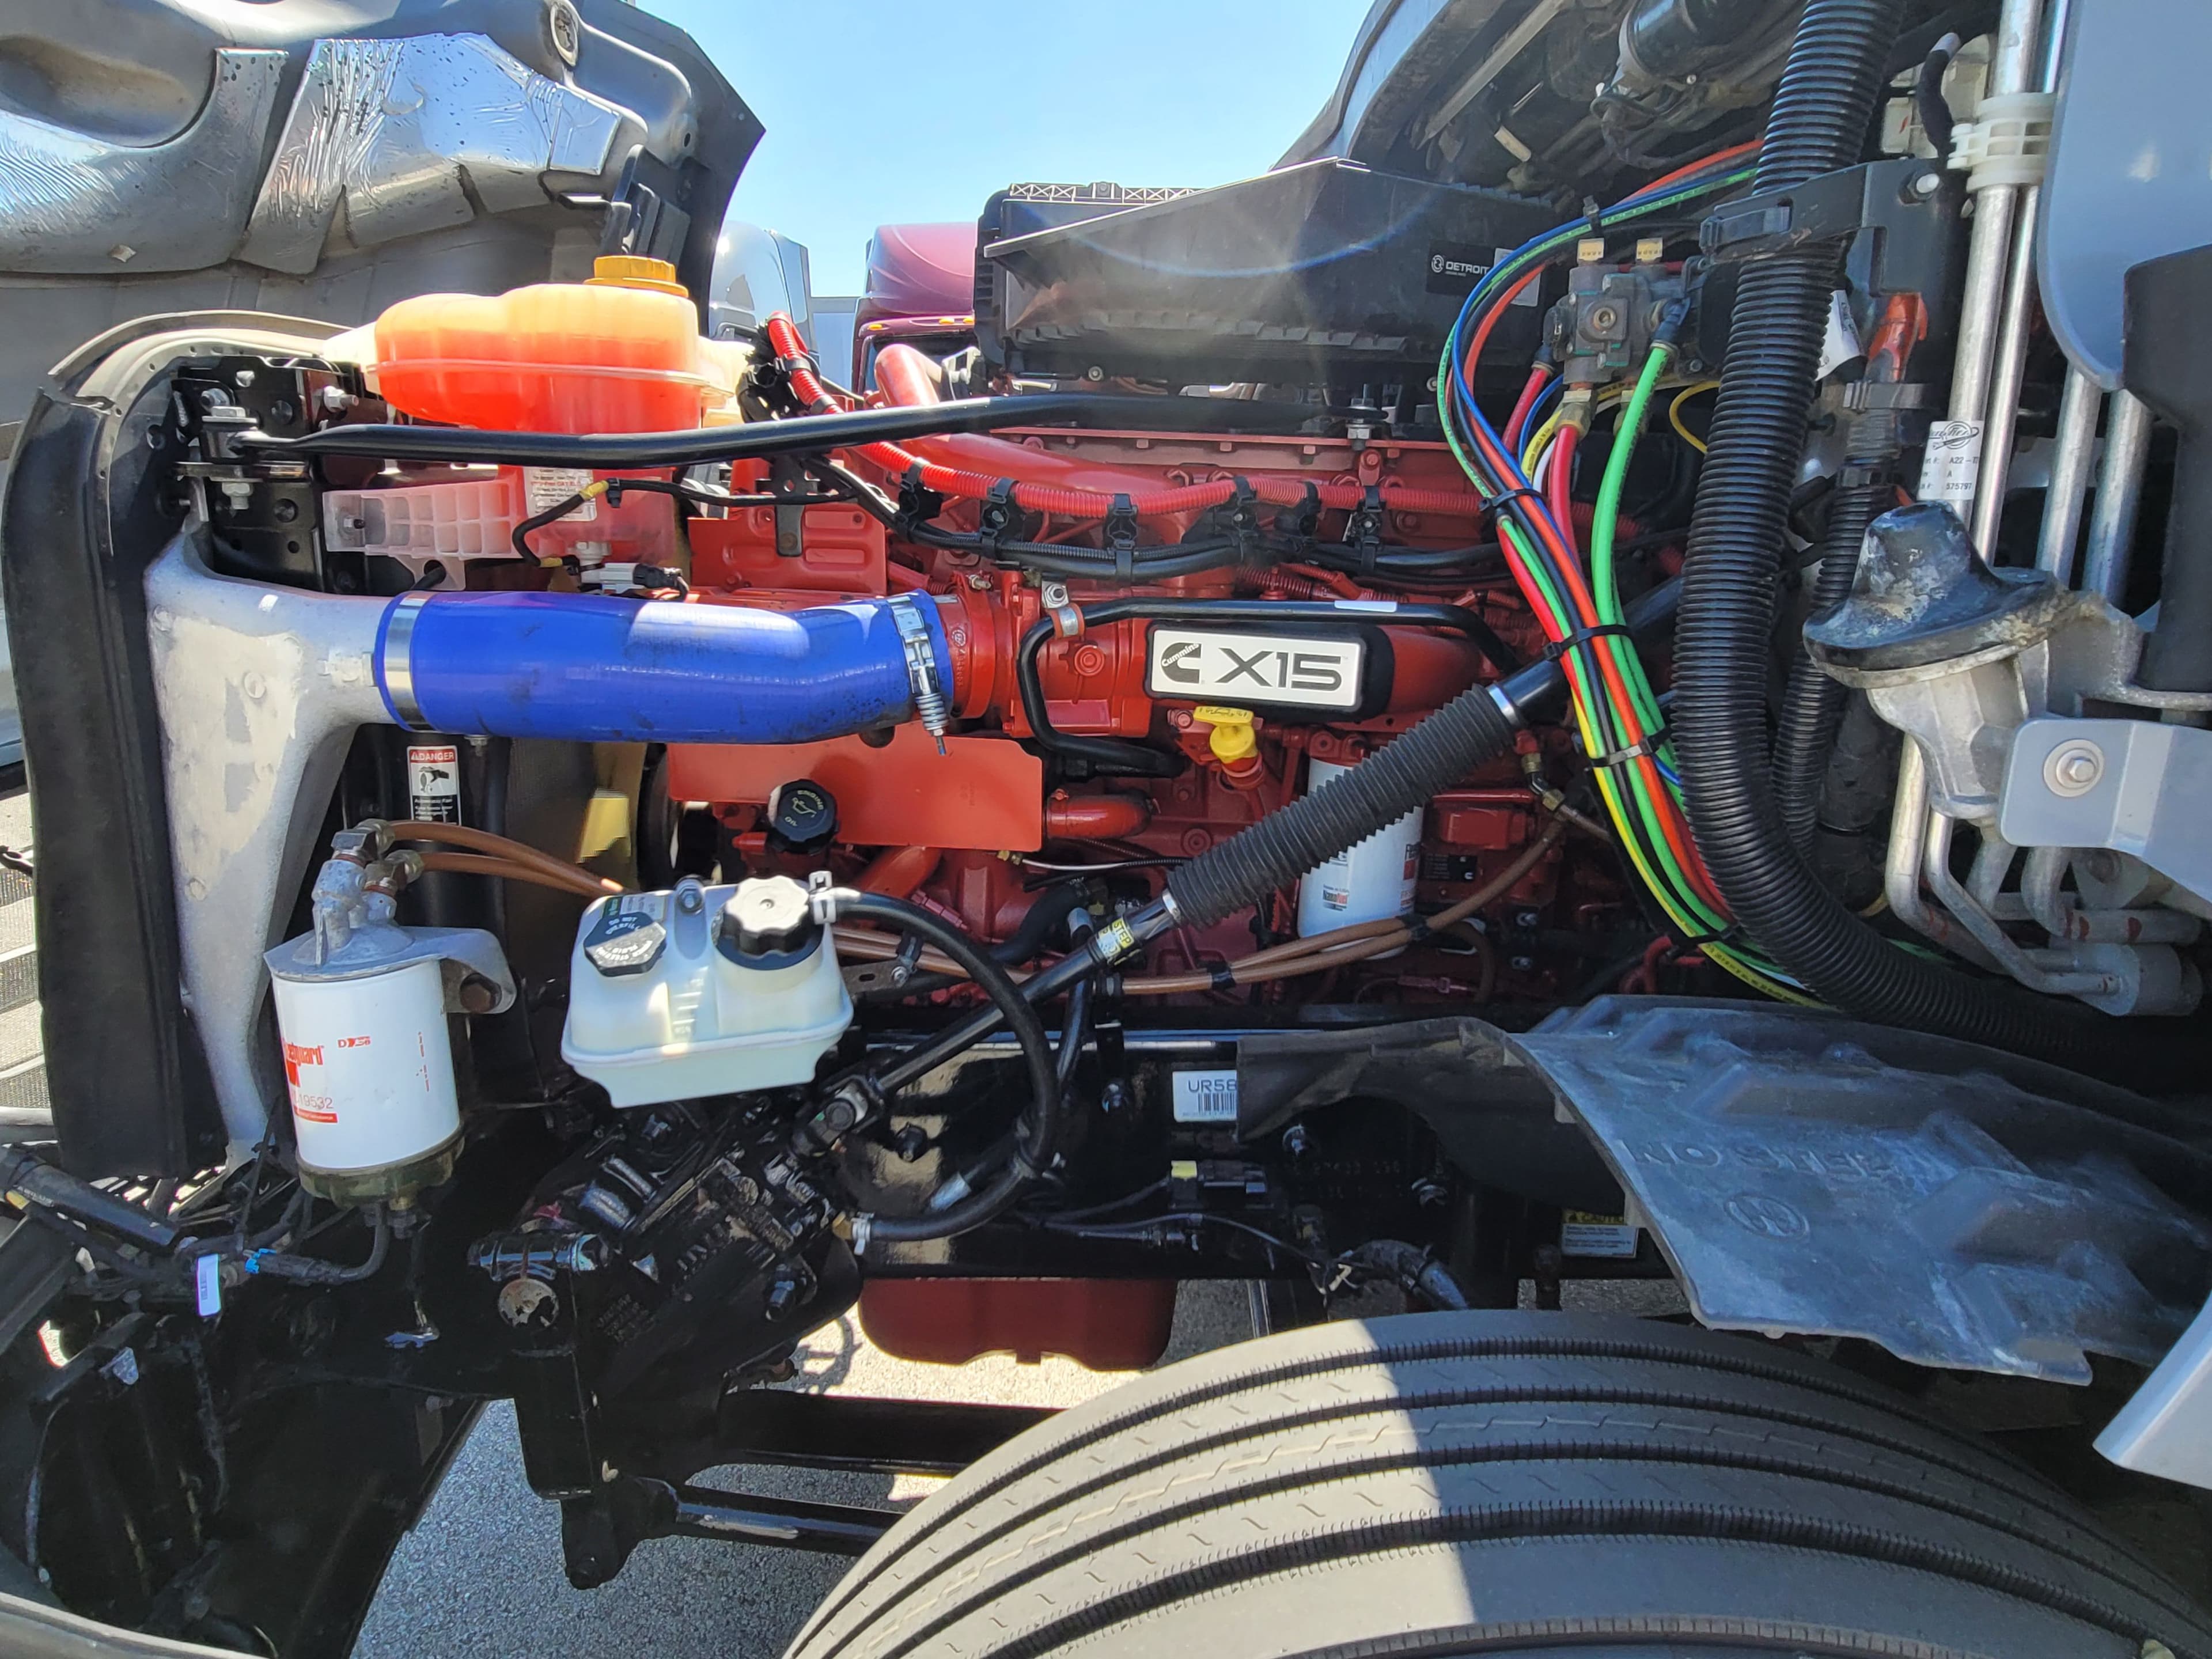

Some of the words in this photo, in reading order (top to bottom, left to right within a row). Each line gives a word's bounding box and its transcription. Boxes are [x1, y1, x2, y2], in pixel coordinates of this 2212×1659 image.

[1446, 261, 1491, 275] DETROIT
[1161, 642, 1200, 667] Cummins
[1214, 647, 1342, 692] X15
[419, 752, 454, 761] DANGER
[797, 790, 824, 810] ENGINE
[784, 816, 798, 827] OIL
[1113, 921, 1131, 944] STEP
[1616, 1139, 1722, 1167] NO
